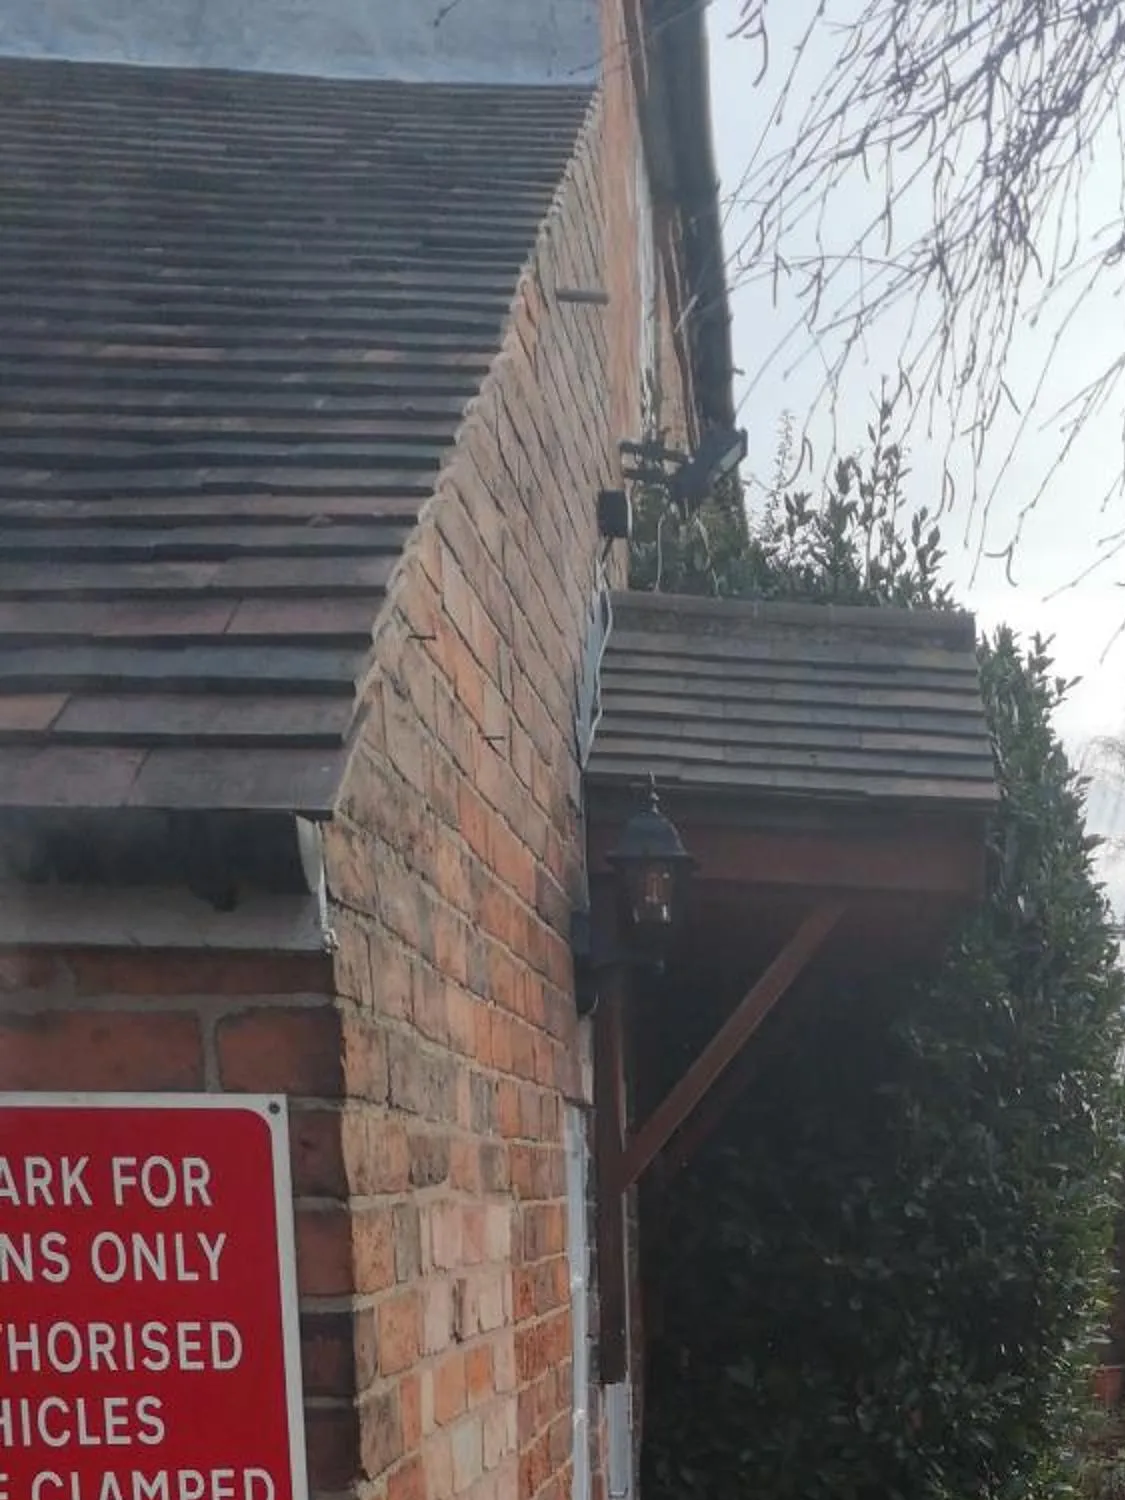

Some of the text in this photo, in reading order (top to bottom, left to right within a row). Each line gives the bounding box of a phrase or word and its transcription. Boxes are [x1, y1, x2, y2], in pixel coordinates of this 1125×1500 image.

[112, 1154, 212, 1207] FOR
[0, 1230, 227, 1284] NS ONLY
[0, 1320, 243, 1374] HORISED
